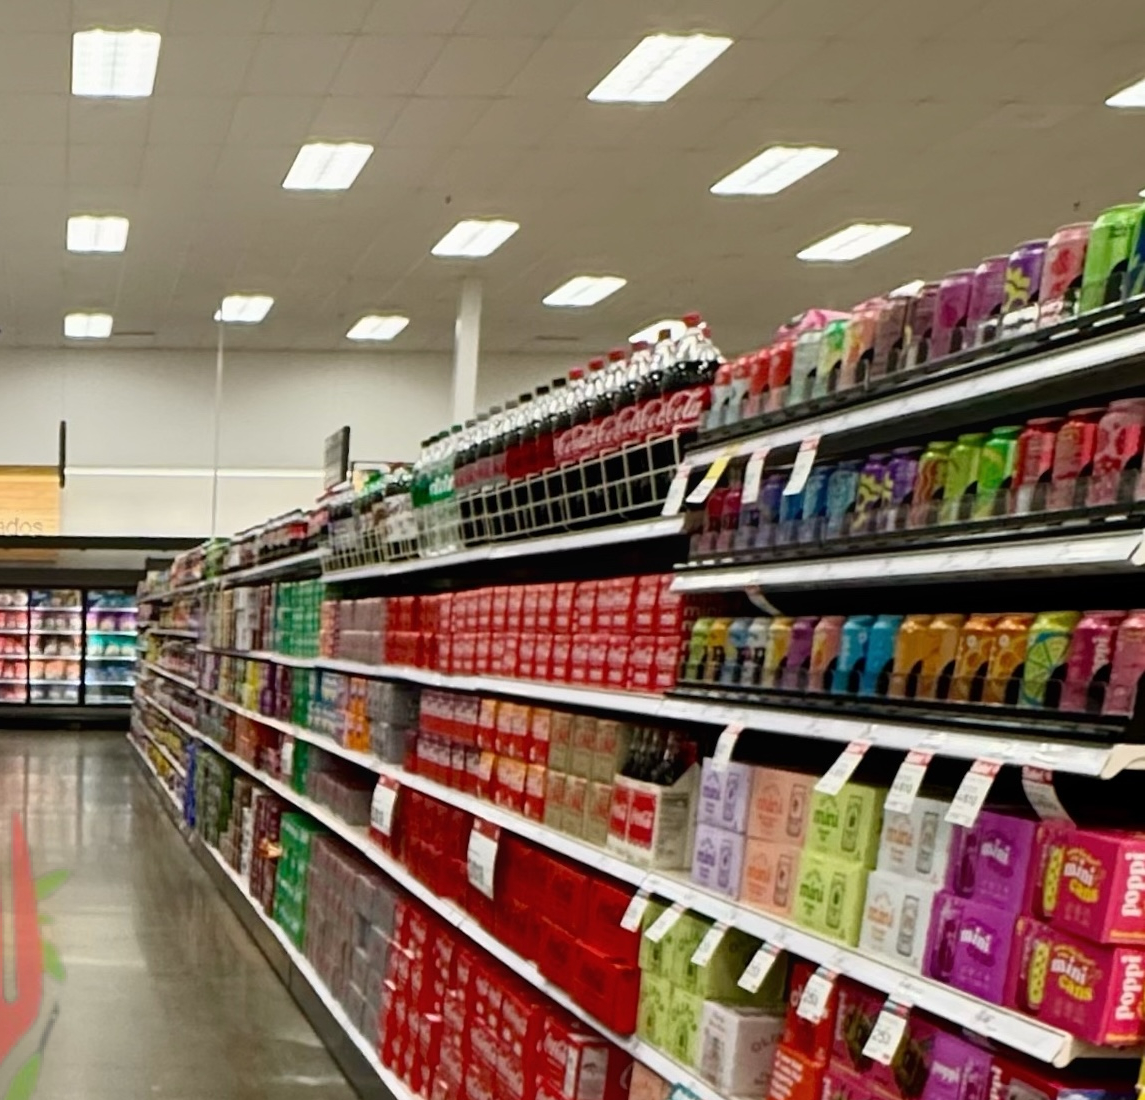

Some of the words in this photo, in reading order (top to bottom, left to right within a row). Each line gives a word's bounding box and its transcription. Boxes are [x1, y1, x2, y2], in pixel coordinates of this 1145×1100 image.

[981, 839, 1011, 865] mini
[1064, 858, 1096, 886] mini
[960, 926, 992, 953] mini
[1051, 956, 1088, 984] mini
[1115, 955, 1144, 1020] poppi
